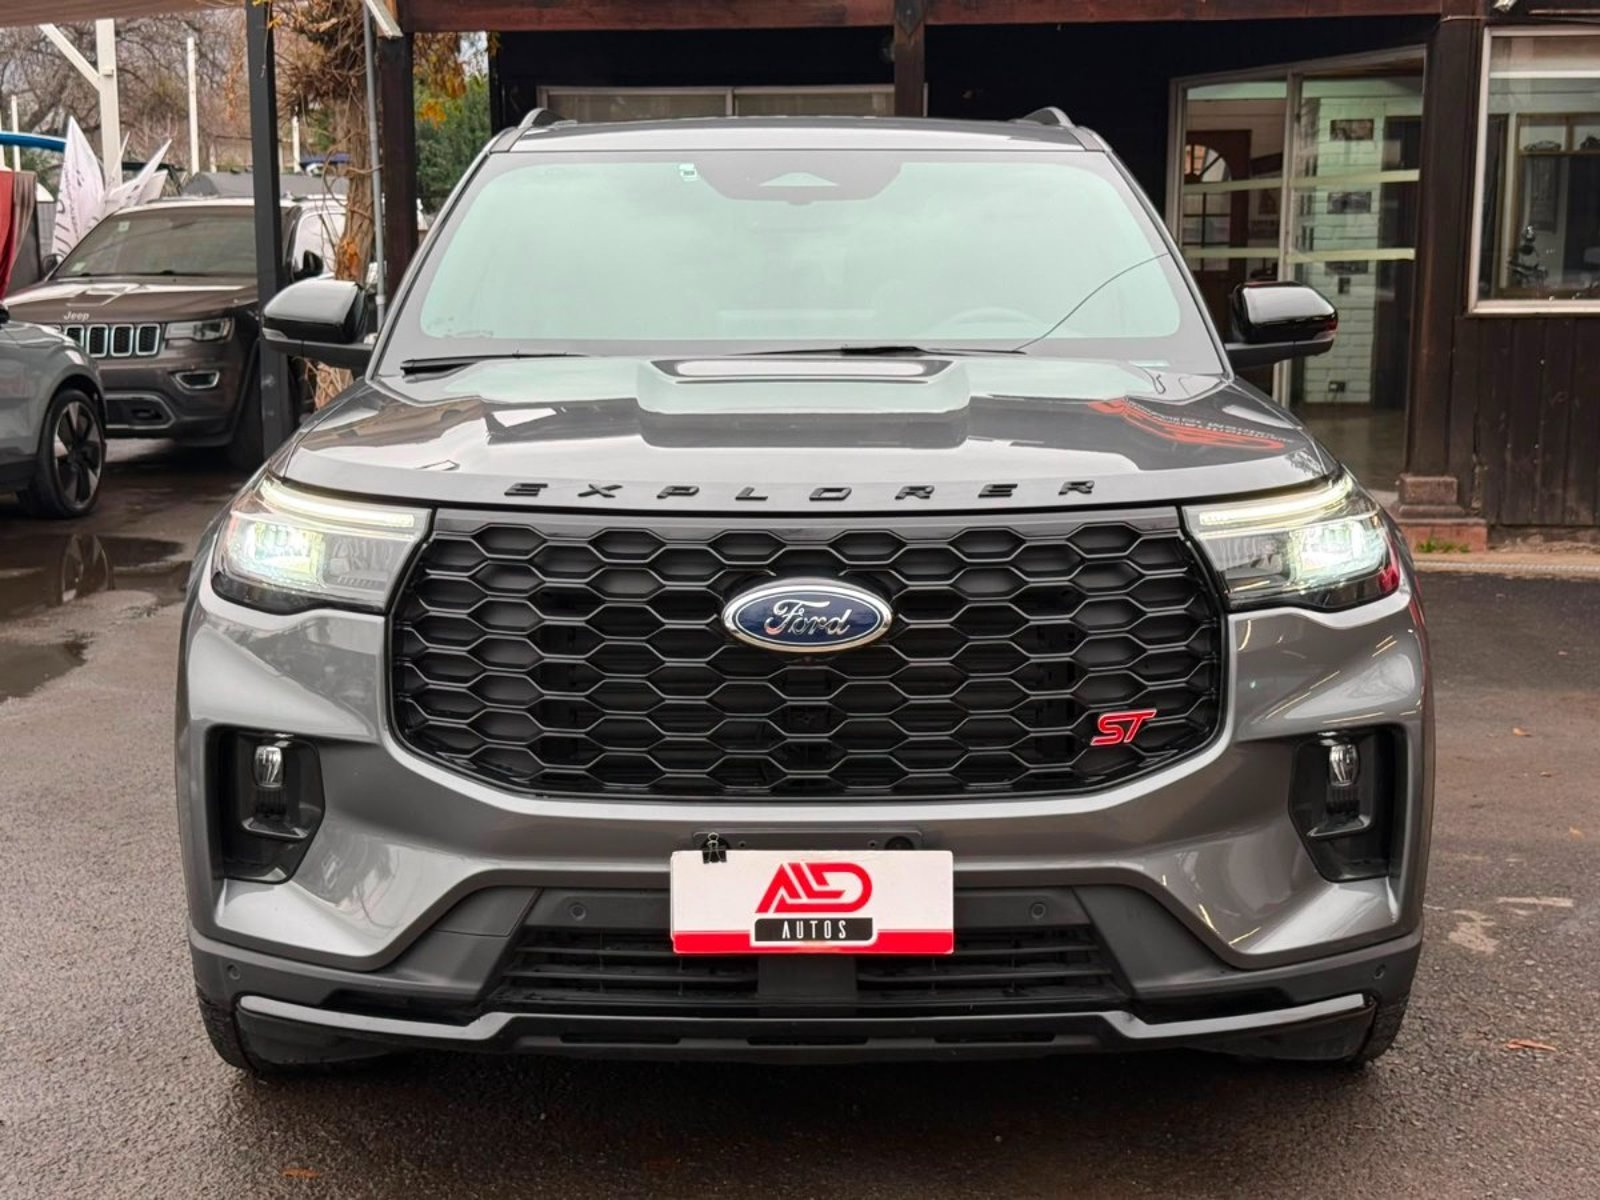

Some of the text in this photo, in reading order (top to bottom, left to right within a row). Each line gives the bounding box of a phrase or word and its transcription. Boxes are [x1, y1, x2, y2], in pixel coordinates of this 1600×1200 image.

[63, 310, 90, 322] Jeep
[503, 480, 1097, 502] EXPLORER
[764, 599, 853, 636] Ford
[1089, 708, 1158, 746] ST
[782, 920, 847, 939] AUTOS
